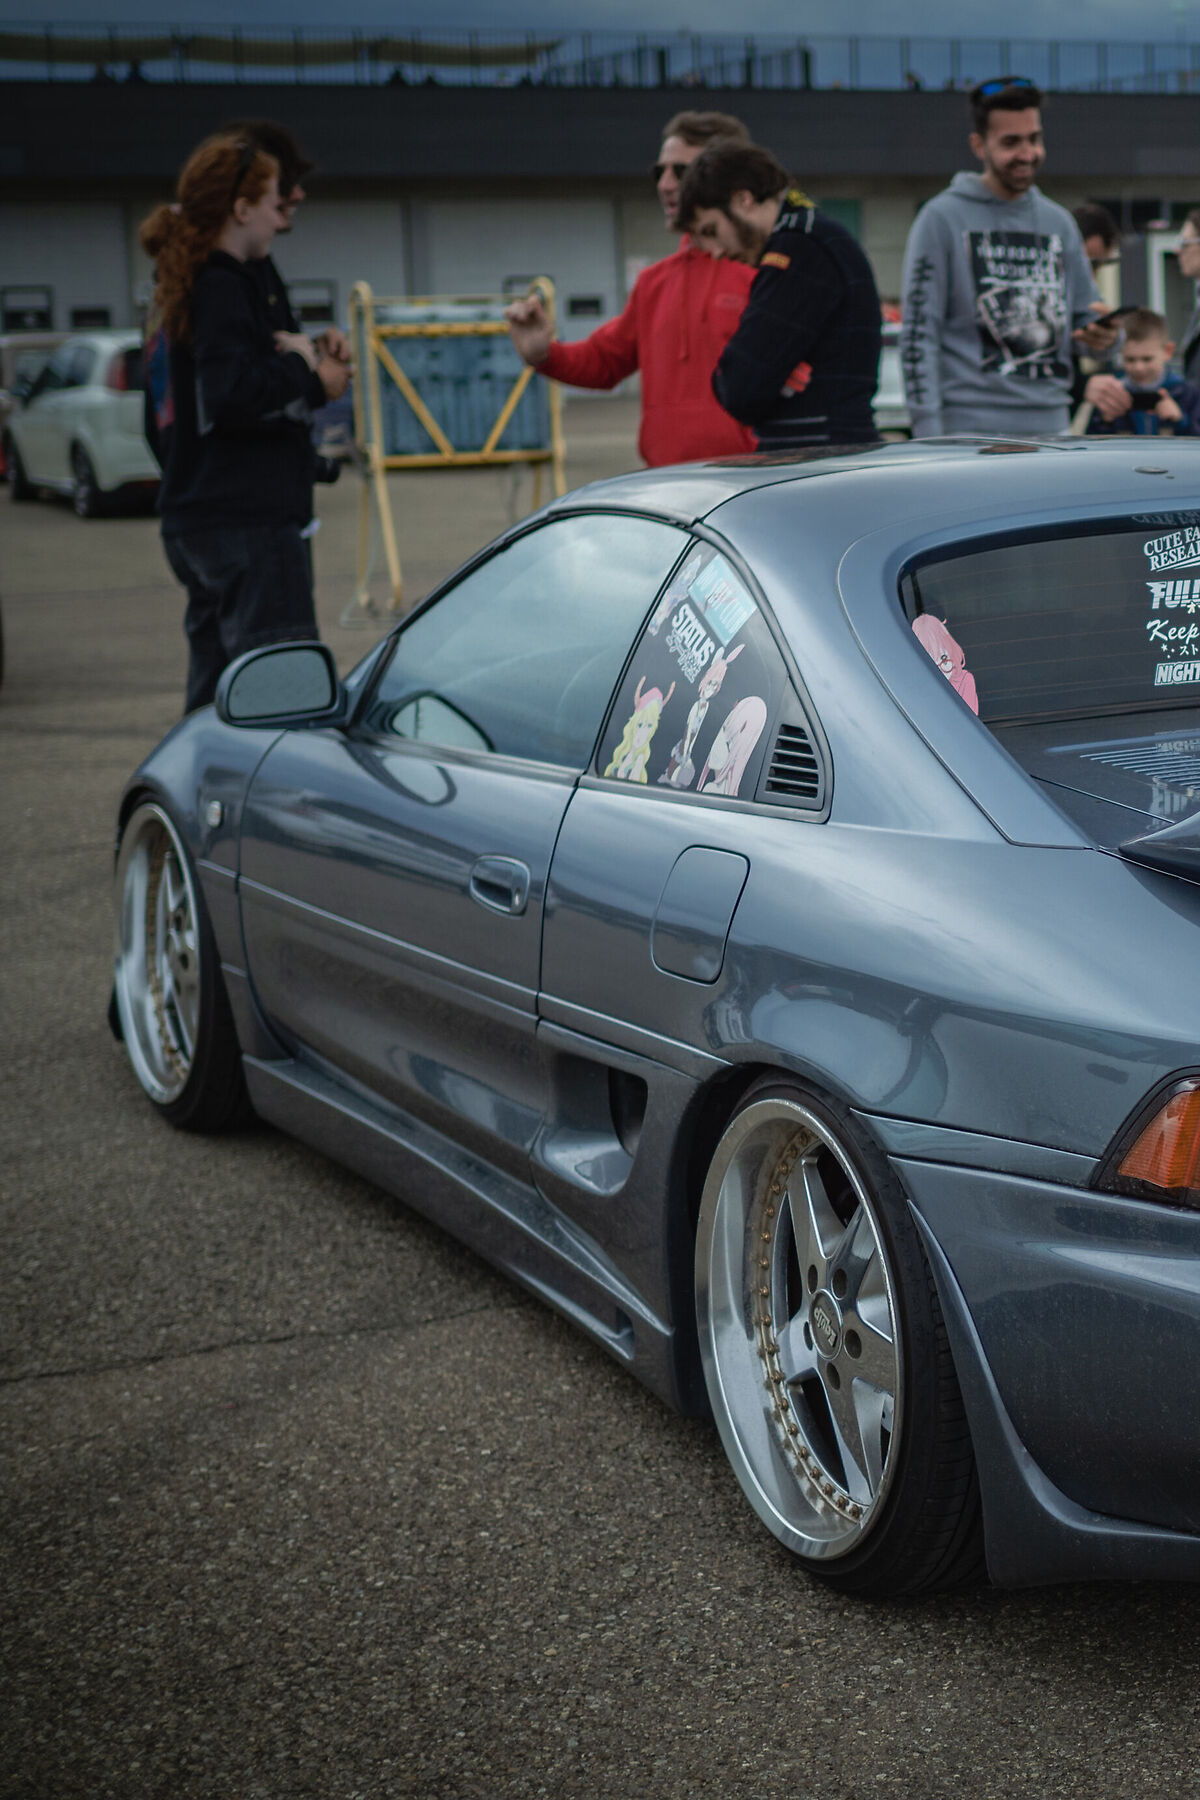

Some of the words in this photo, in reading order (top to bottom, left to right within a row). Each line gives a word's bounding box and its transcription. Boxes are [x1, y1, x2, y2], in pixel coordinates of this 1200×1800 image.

[1143, 532, 1183, 557] CUTE
[671, 603, 715, 667] STATUS
[1146, 619, 1200, 644] Keep
